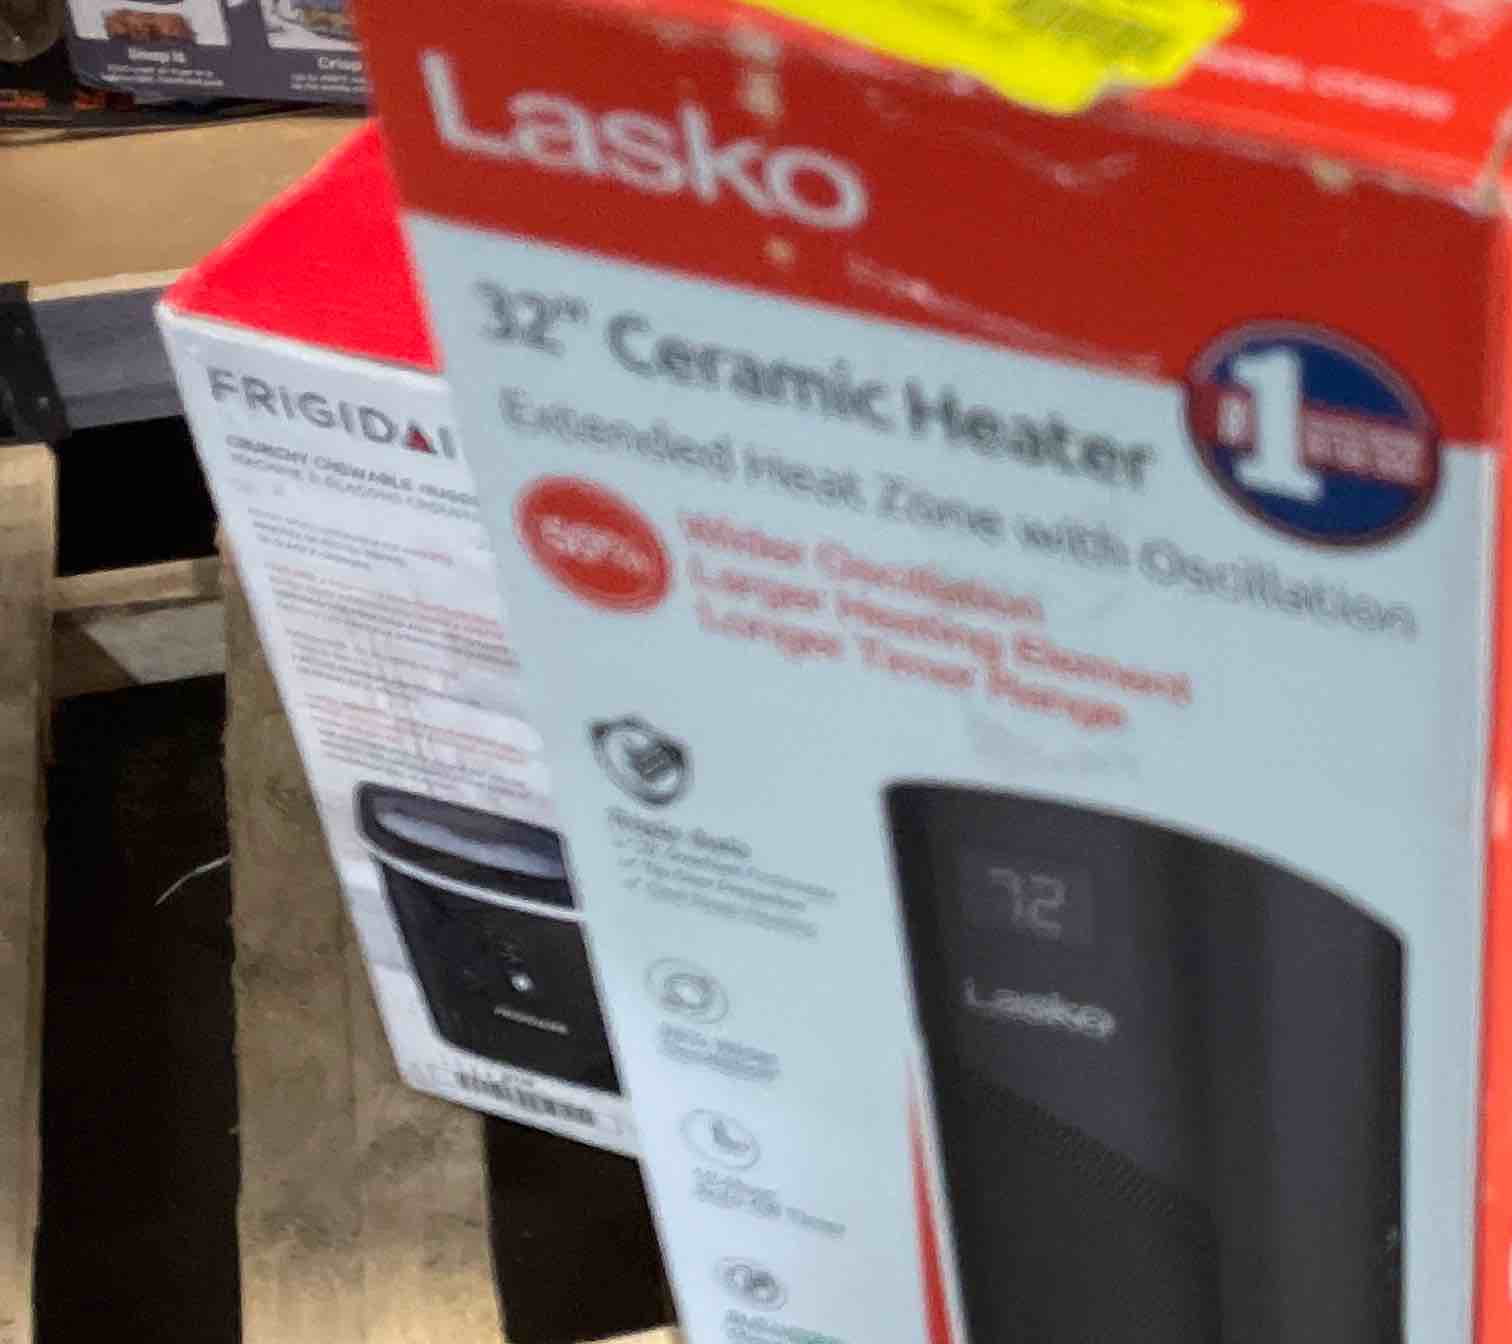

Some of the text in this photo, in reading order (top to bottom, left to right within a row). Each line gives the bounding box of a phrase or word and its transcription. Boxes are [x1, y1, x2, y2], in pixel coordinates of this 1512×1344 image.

[420, 48, 869, 230] Lasko
[473, 278, 1156, 495] 32" Ceramic Heater
[500, 385, 1420, 640] Extended Heat Zone with Oscillation
[814, 541, 1044, 622] Oscillation
[1013, 633, 1194, 706] Element
[963, 976, 1118, 1043] Lasko
